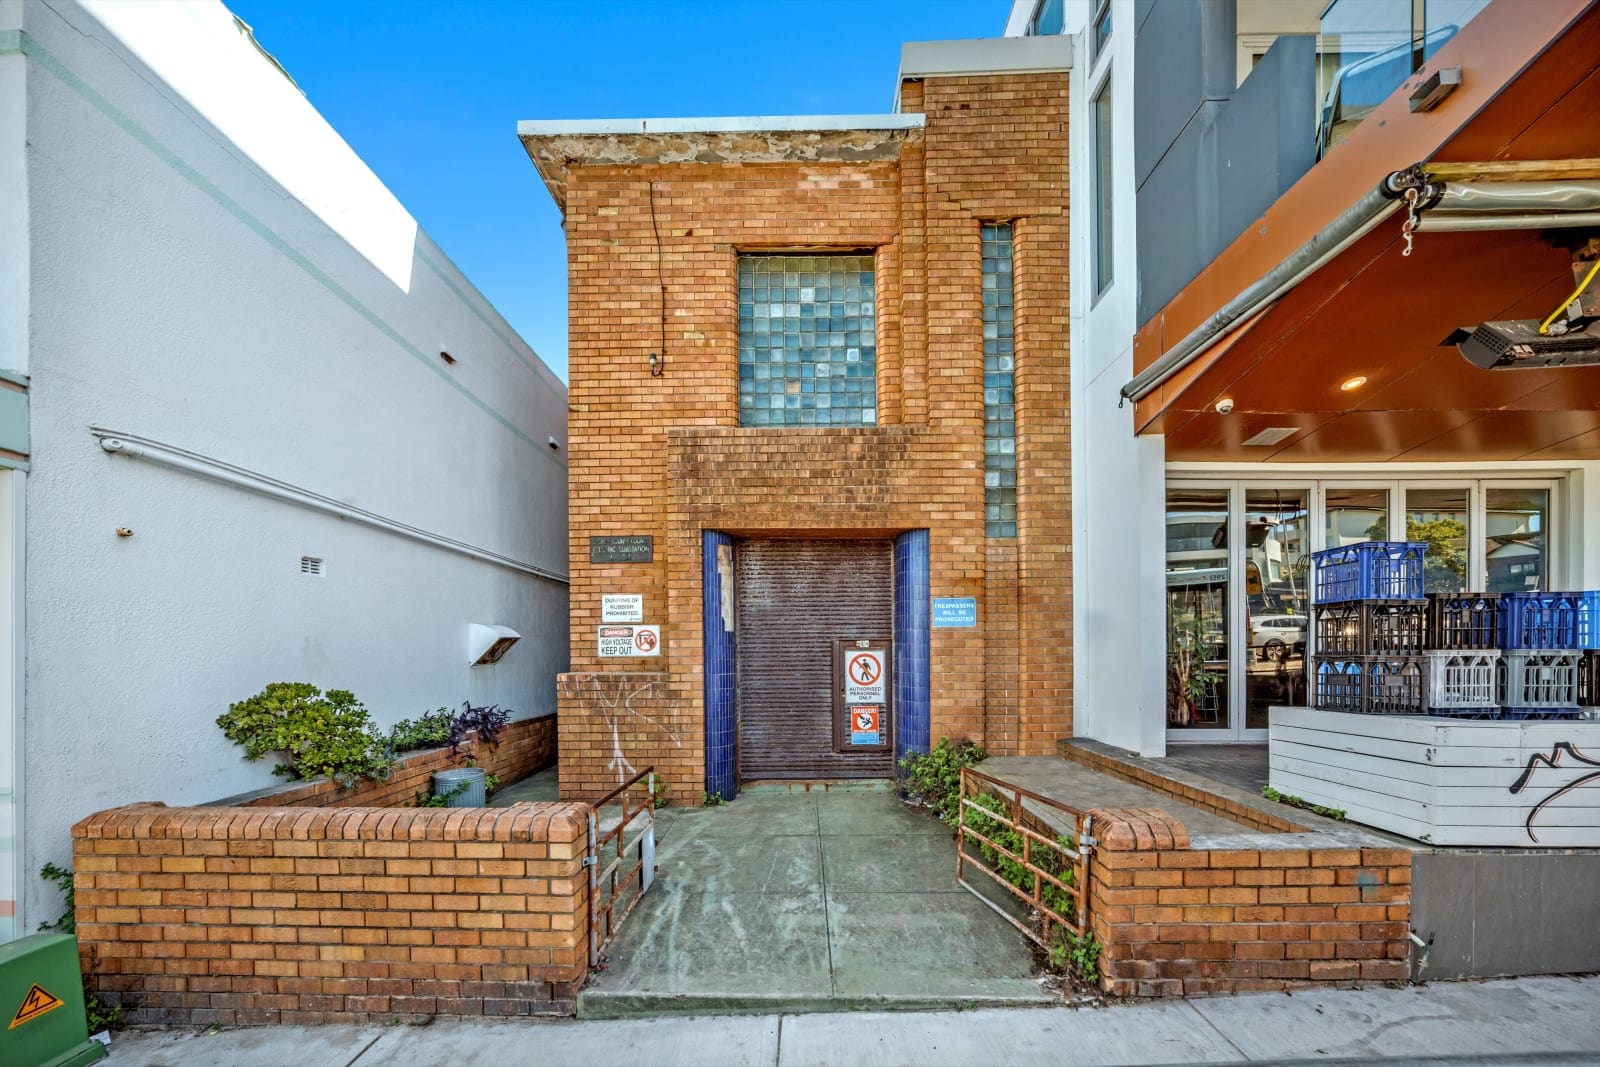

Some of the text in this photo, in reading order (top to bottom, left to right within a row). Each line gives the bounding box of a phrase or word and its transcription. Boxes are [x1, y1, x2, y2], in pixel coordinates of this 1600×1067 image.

[601, 638, 633, 646] HIGH VOLTAGE
[601, 646, 633, 655] KEEP OUT
